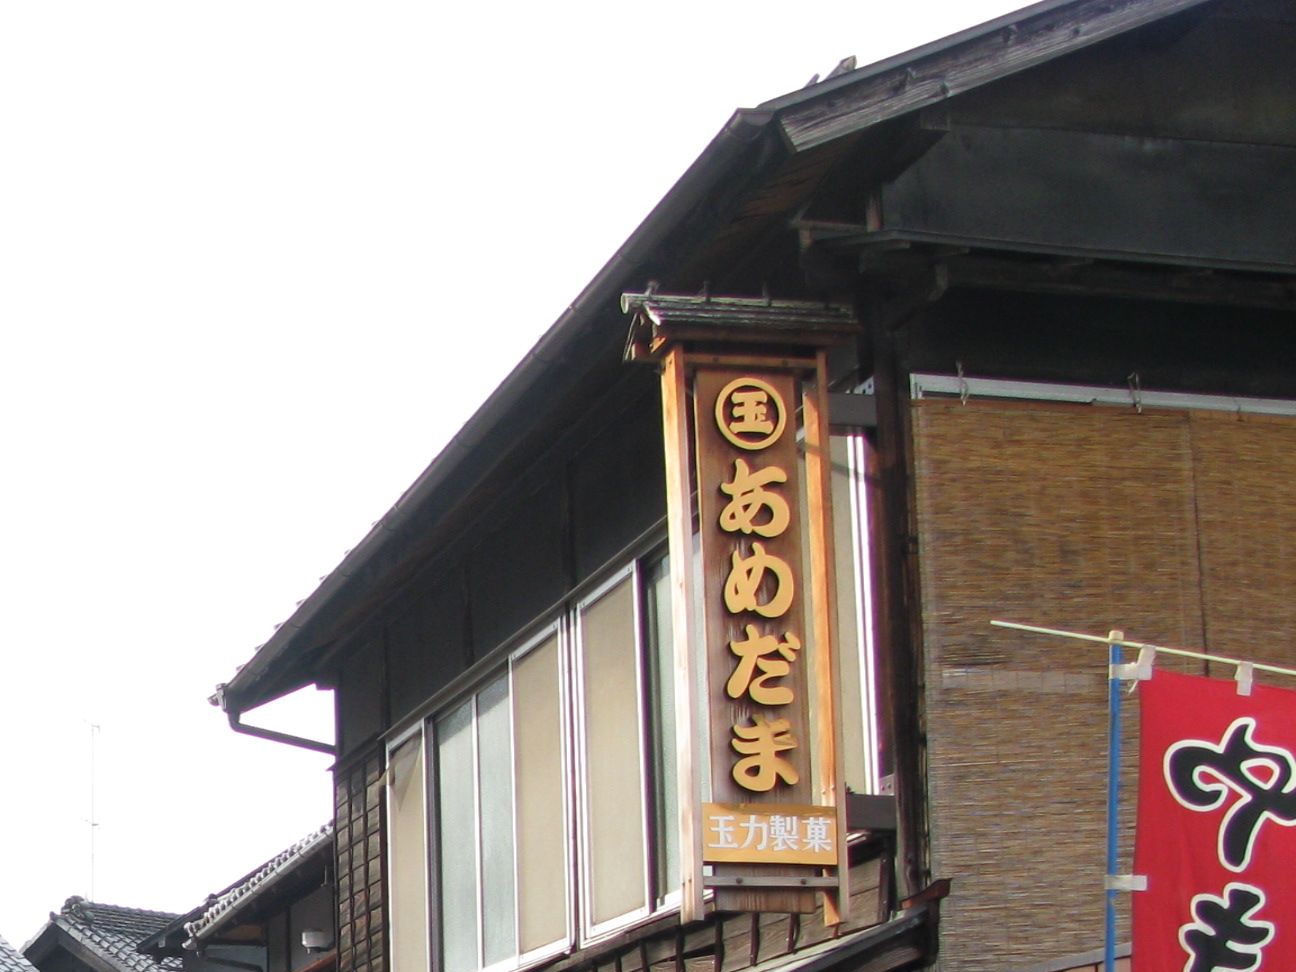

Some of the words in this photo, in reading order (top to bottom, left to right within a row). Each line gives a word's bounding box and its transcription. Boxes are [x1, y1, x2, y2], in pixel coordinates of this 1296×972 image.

[719, 458, 801, 792] あめだま
[707, 814, 833, 853] 玉力製菓
